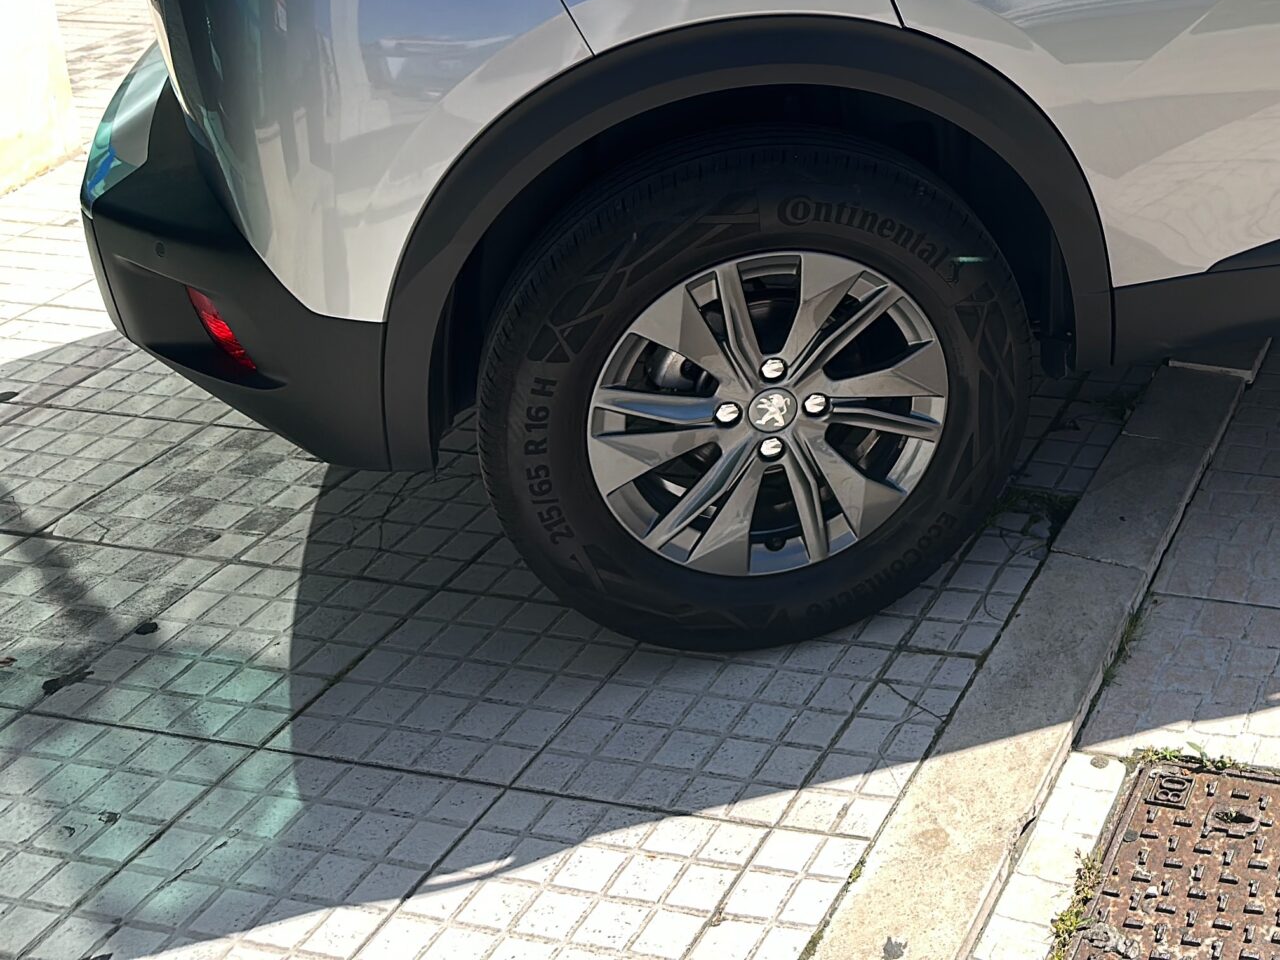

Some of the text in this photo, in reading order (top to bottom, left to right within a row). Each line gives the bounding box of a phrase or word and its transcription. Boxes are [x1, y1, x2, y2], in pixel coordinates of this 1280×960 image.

[776, 194, 950, 272] Continental
[523, 376, 576, 546] 215/65 R 16 H
